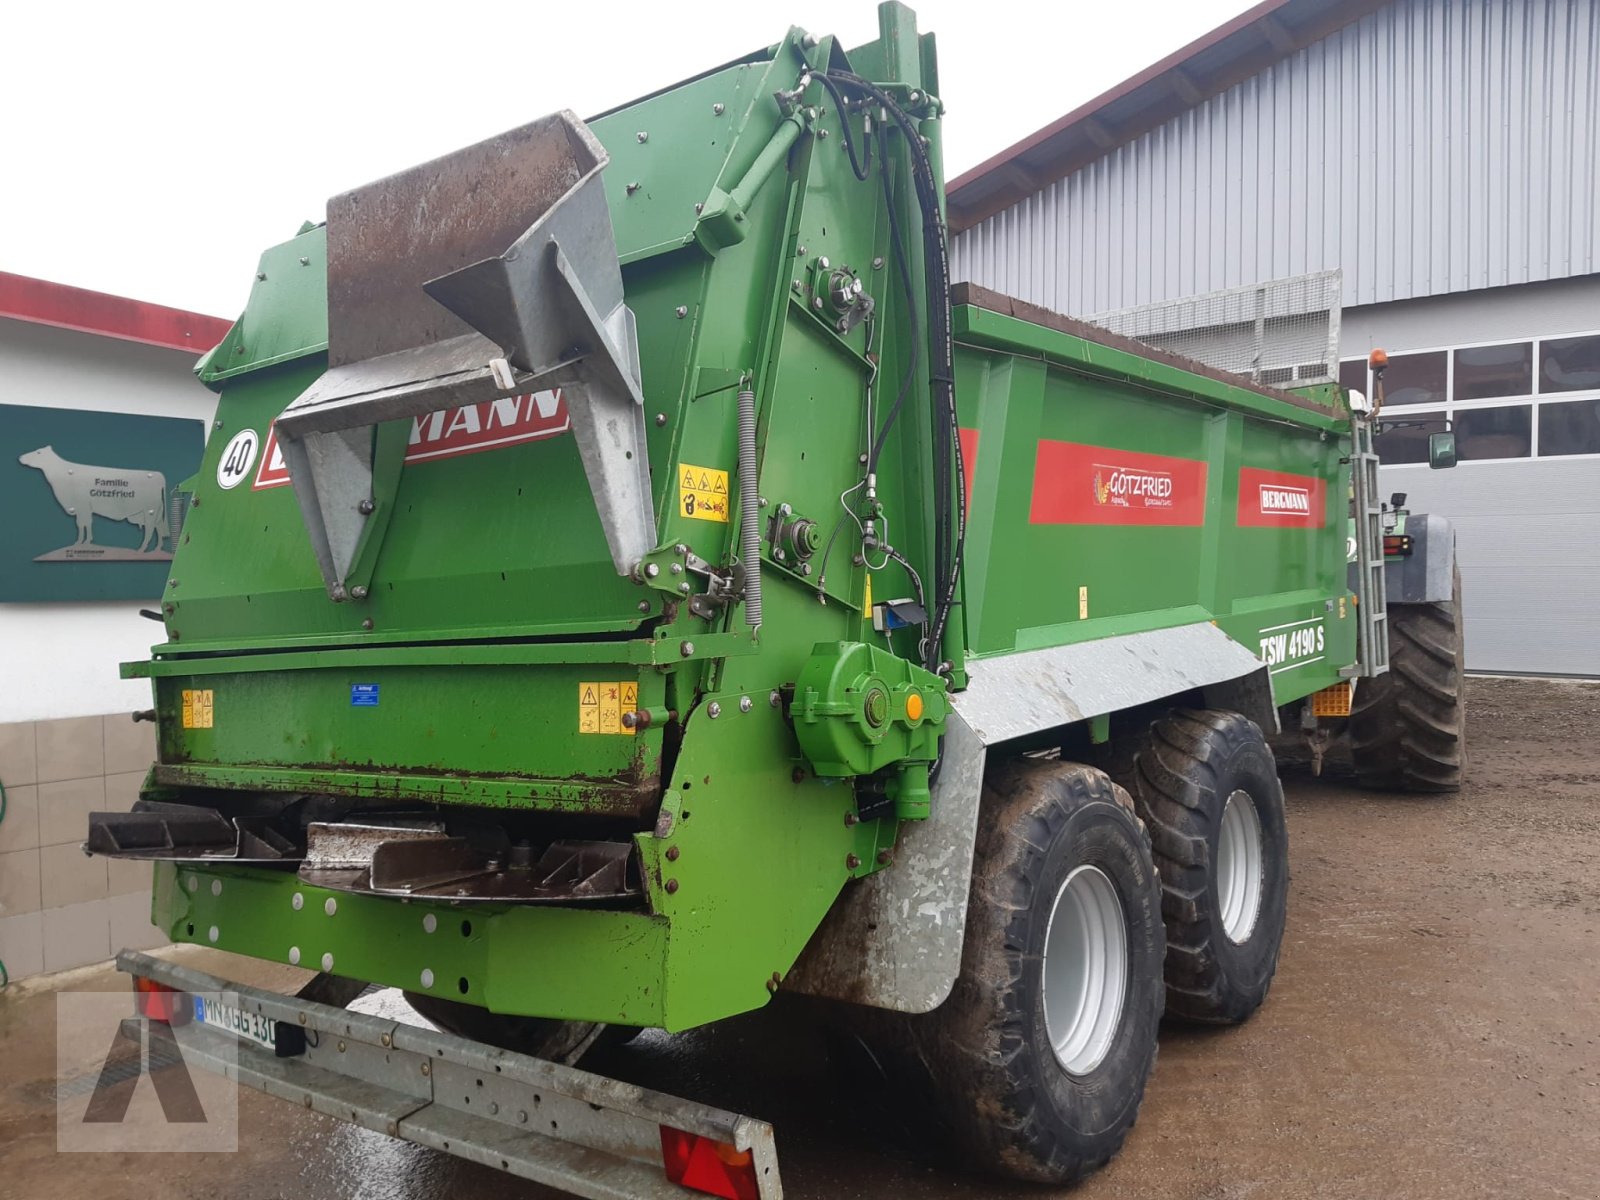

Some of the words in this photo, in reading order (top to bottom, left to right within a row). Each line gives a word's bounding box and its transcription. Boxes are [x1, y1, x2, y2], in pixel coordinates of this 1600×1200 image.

[222, 438, 252, 477] 40
[95, 478, 128, 488] Familie
[1110, 467, 1172, 498] GÖTZFRIED
[1262, 490, 1308, 510] BERGMANN
[1259, 633, 1287, 666] TSW
[1288, 627, 1315, 659] 4190
[1316, 625, 1325, 652] S
[204, 998, 223, 1025] MN
[231, 1007, 250, 1034] GG
